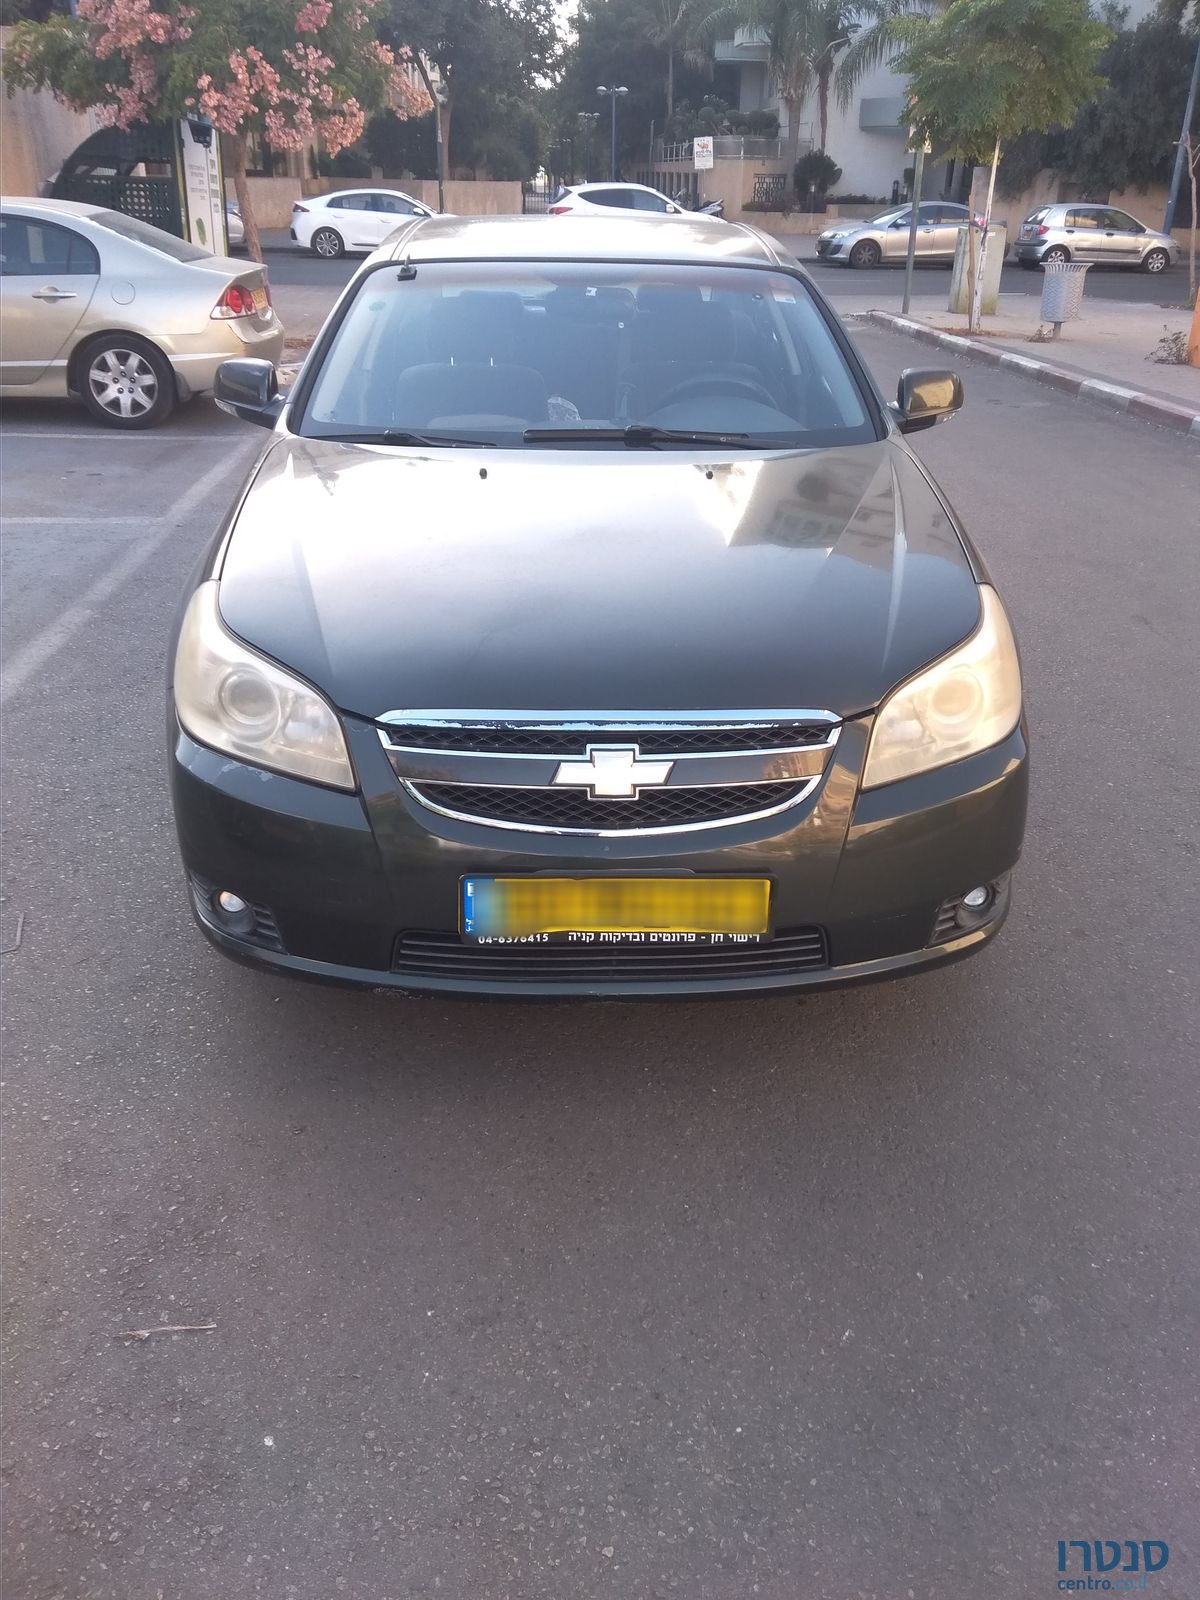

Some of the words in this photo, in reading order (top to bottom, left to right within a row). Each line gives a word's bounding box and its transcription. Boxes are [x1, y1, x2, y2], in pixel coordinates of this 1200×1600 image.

[568, 931, 595, 943] קניה
[599, 932, 645, 943] ובדיקות
[649, 932, 696, 942] פרונטים
[710, 933, 724, 944] חן
